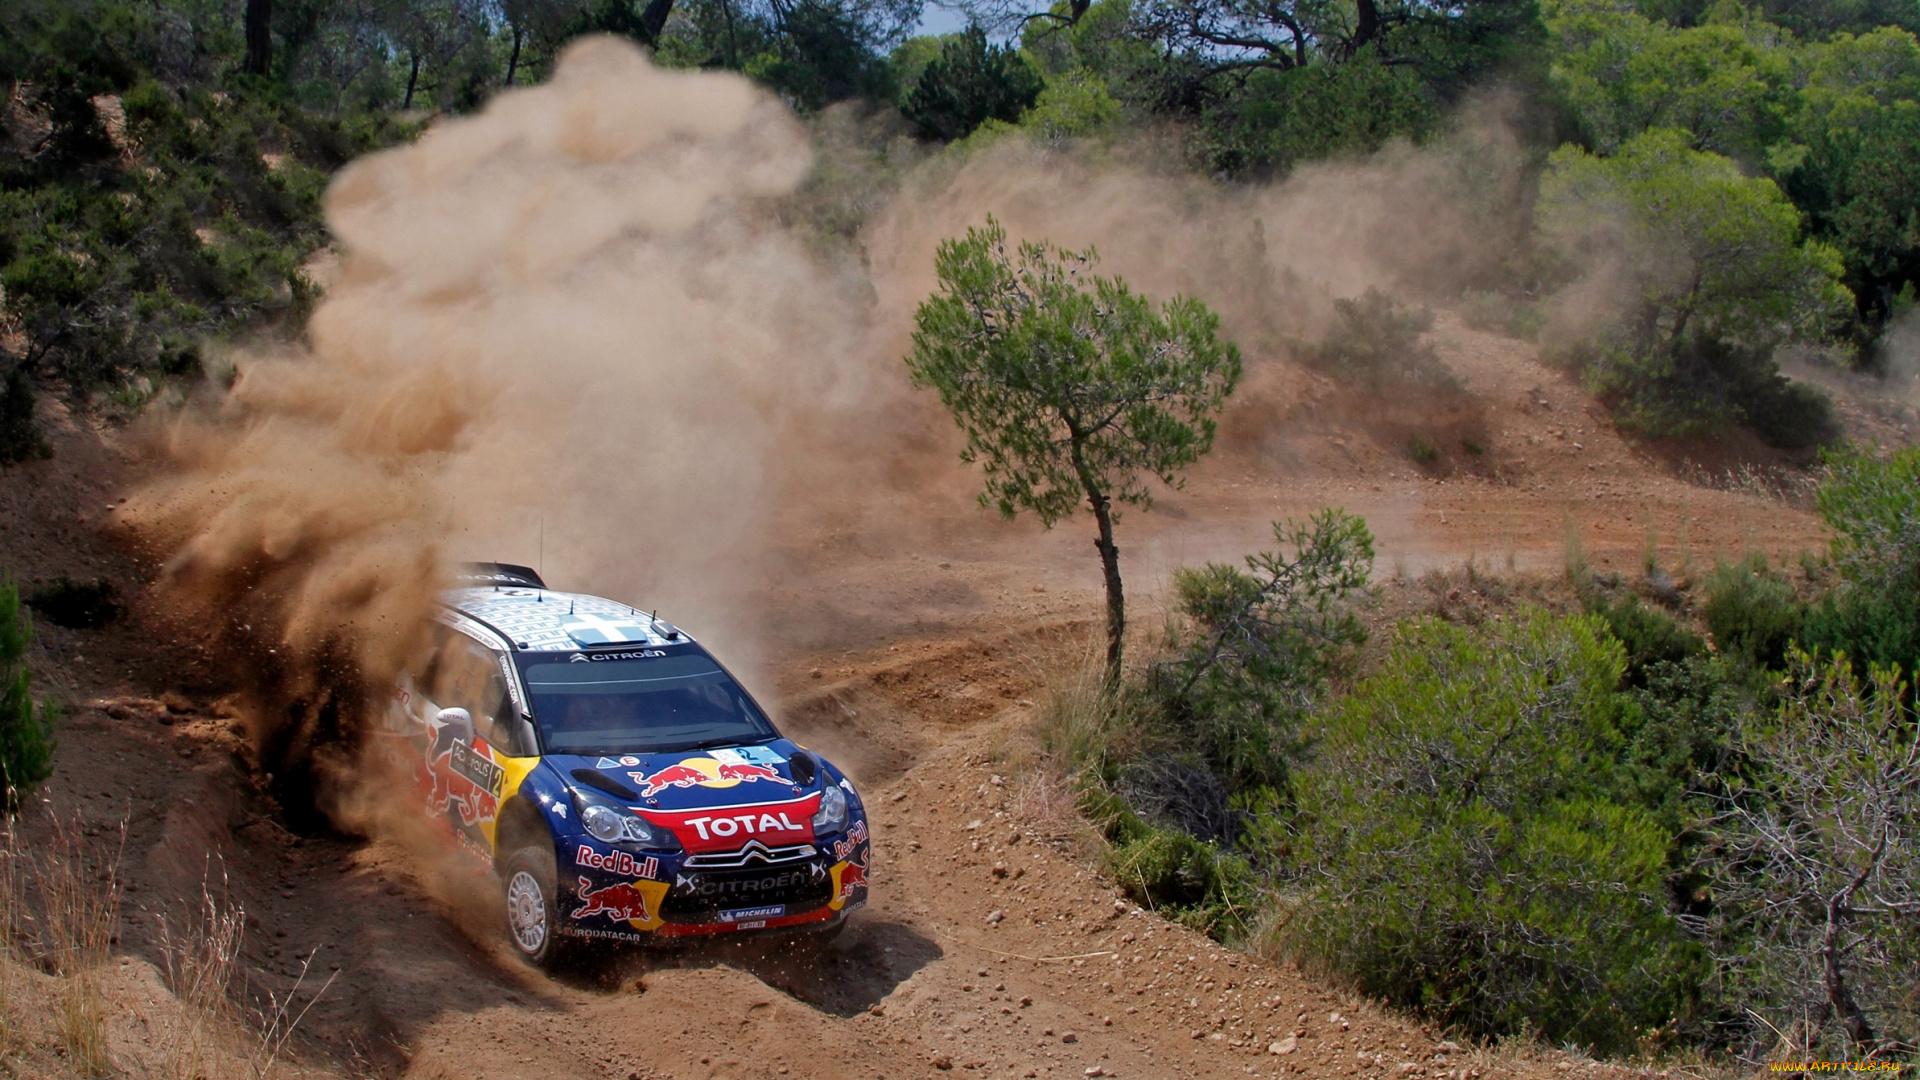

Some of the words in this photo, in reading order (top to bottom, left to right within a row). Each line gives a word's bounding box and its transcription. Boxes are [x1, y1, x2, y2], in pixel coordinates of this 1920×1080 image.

[591, 649, 667, 661] CITROËN
[736, 748, 759, 760] 2
[492, 768, 502, 796] 2
[684, 812, 804, 840] TOTAL
[735, 907, 782, 918] MICHELIN
